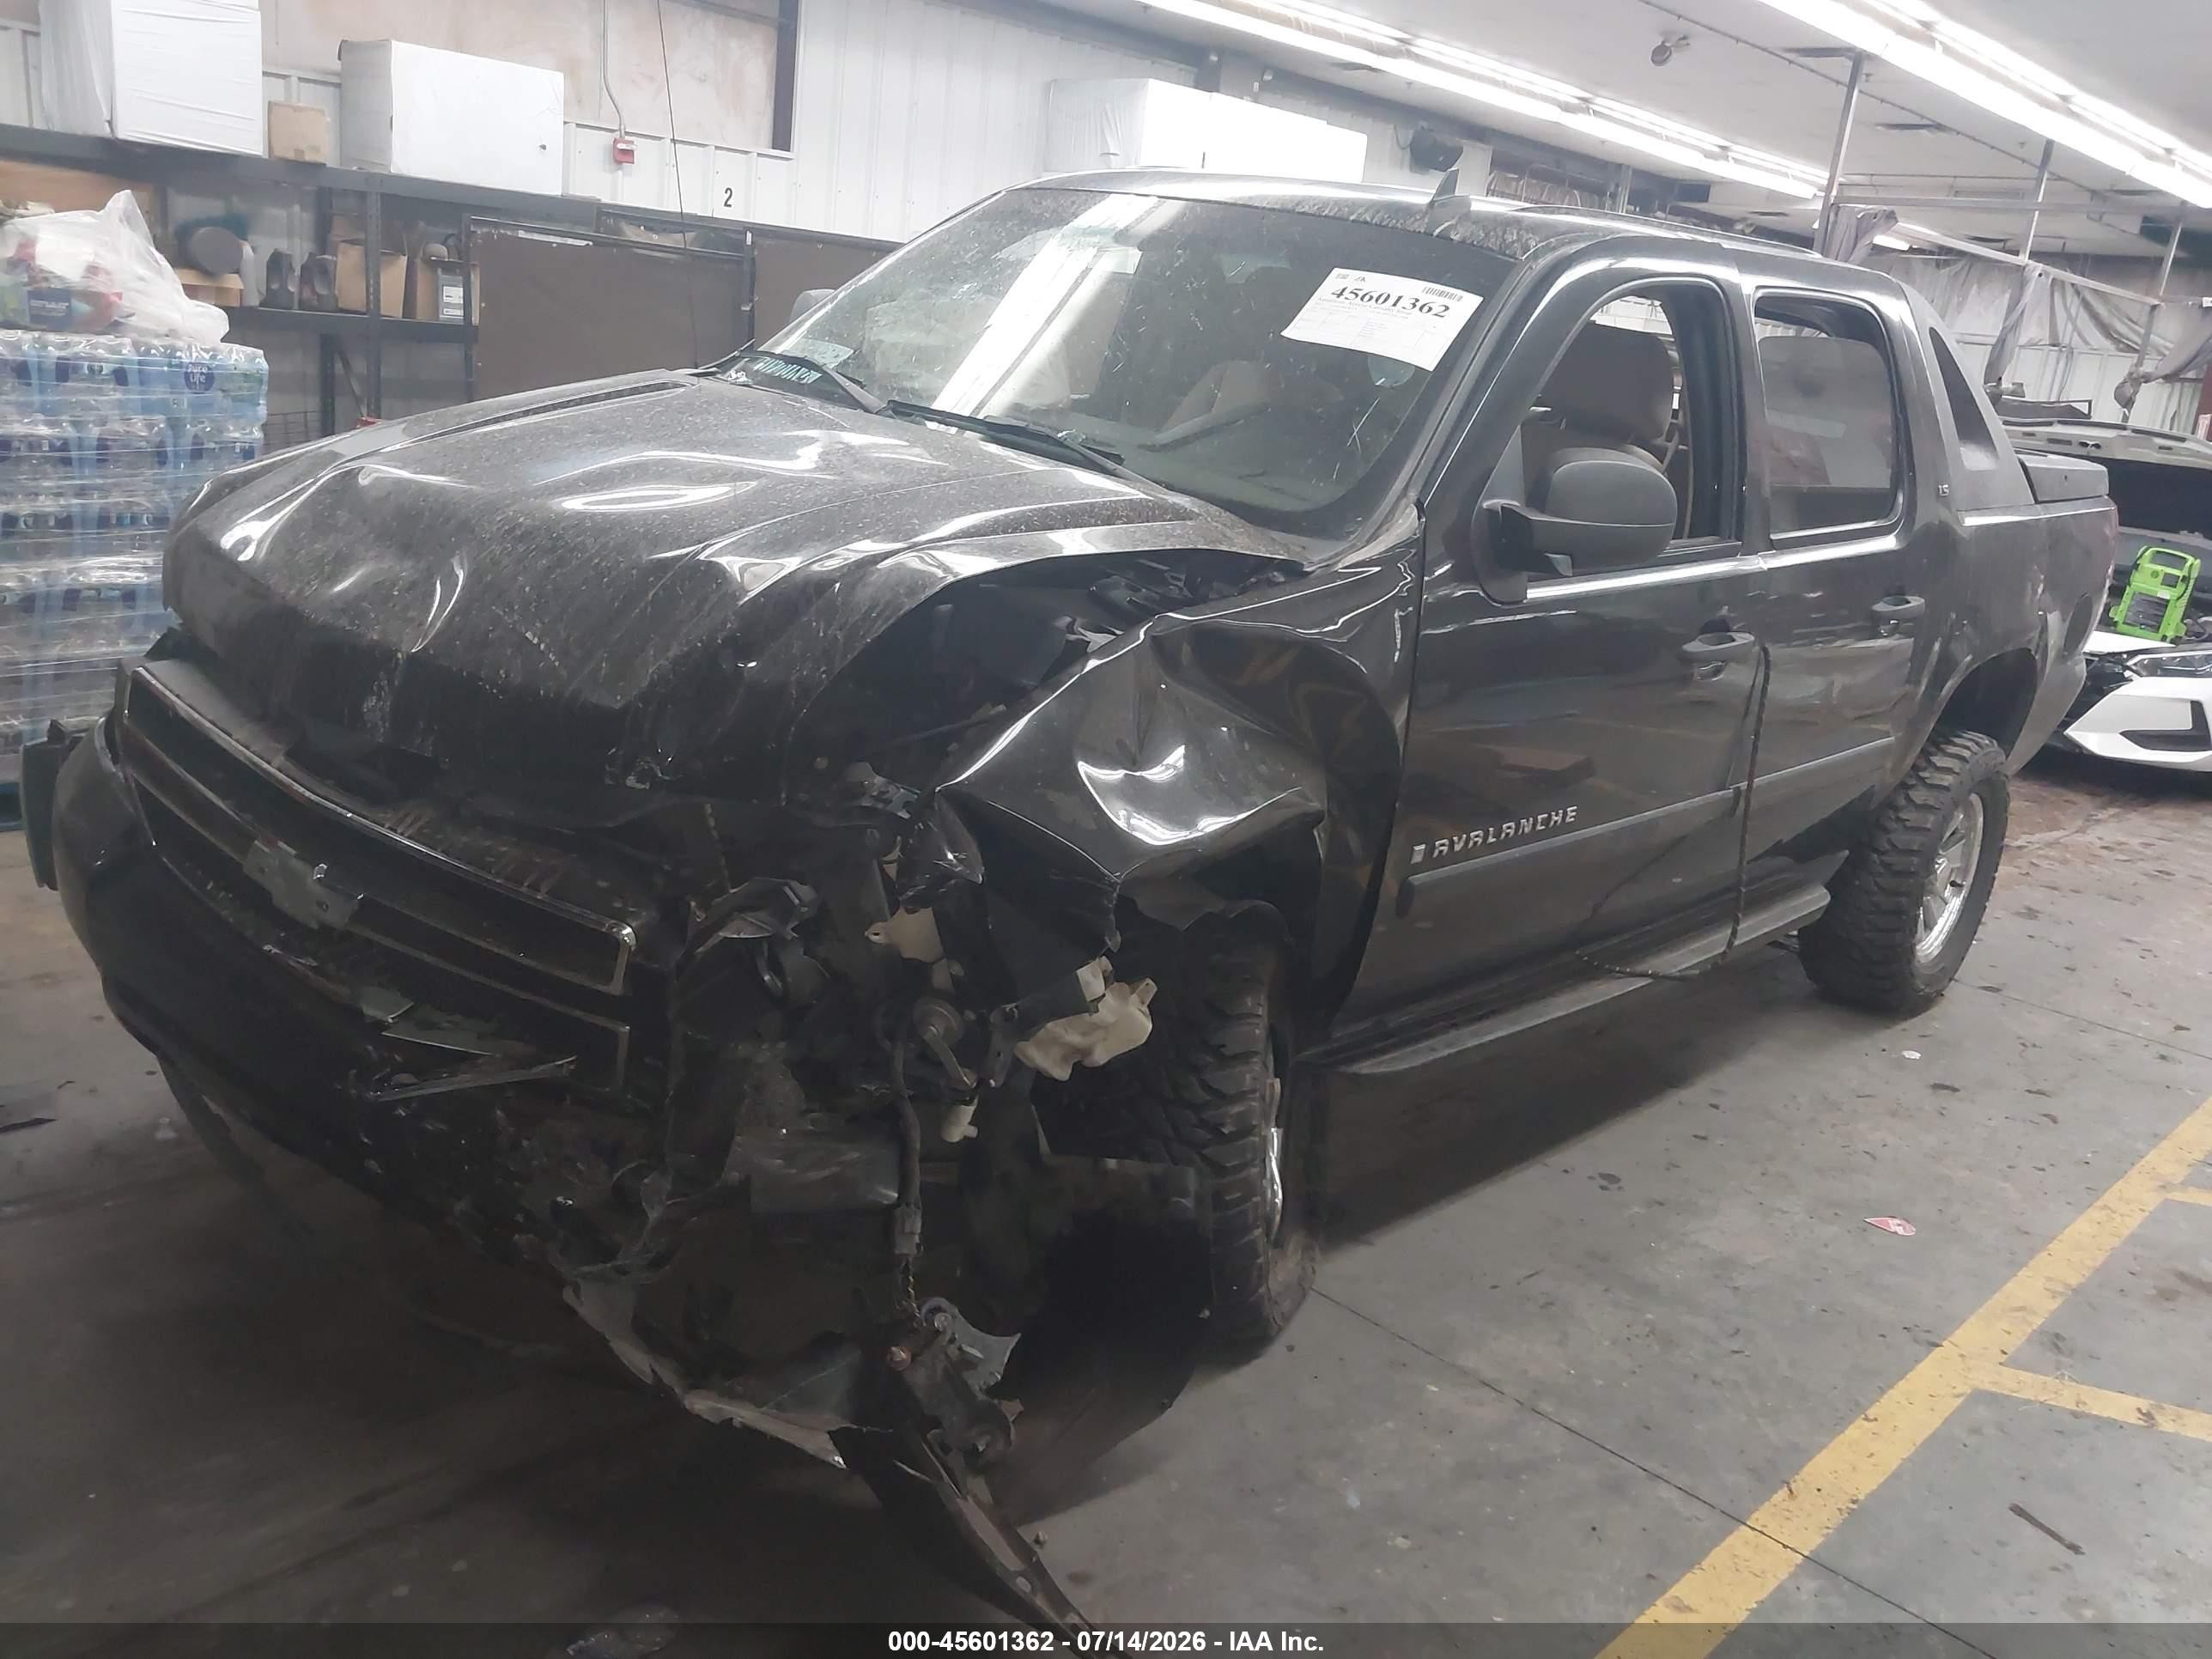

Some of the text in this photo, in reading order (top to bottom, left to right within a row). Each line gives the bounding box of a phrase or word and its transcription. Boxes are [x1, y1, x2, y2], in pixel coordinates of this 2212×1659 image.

[723, 187, 733, 208] 2
[1330, 285, 1450, 319] 45601362
[1431, 805, 1579, 859] AVALANCHE
